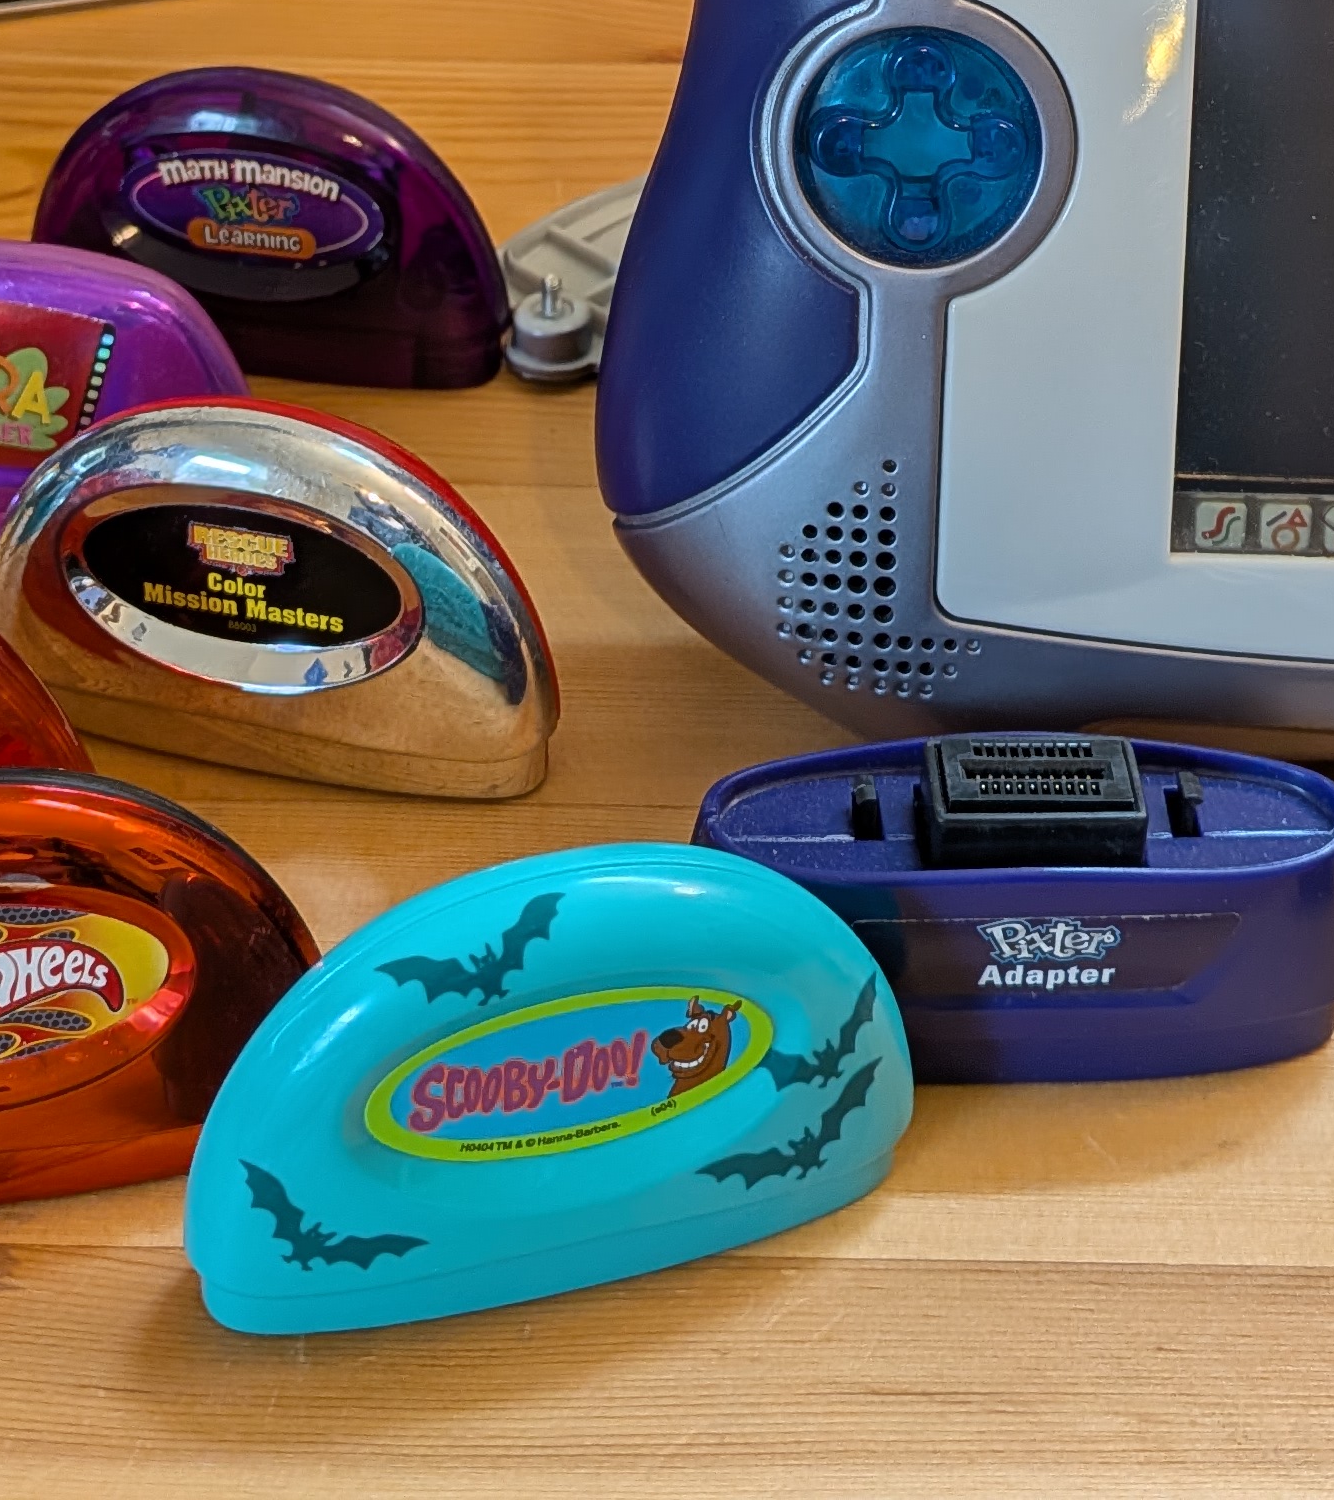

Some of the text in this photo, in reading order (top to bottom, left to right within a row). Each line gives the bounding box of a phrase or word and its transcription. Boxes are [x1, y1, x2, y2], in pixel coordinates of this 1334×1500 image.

[197, 185, 299, 223] Pixter
[203, 225, 302, 251] Learning
[192, 523, 292, 559] RESCUE
[205, 543, 280, 570] HEROES
[207, 572, 267, 599] Color
[143, 581, 344, 633] Mission Masters
[980, 920, 1118, 961] Pixter
[978, 965, 1116, 989] Adapter
[408, 1030, 649, 1133] SCOOBY-DOO!
